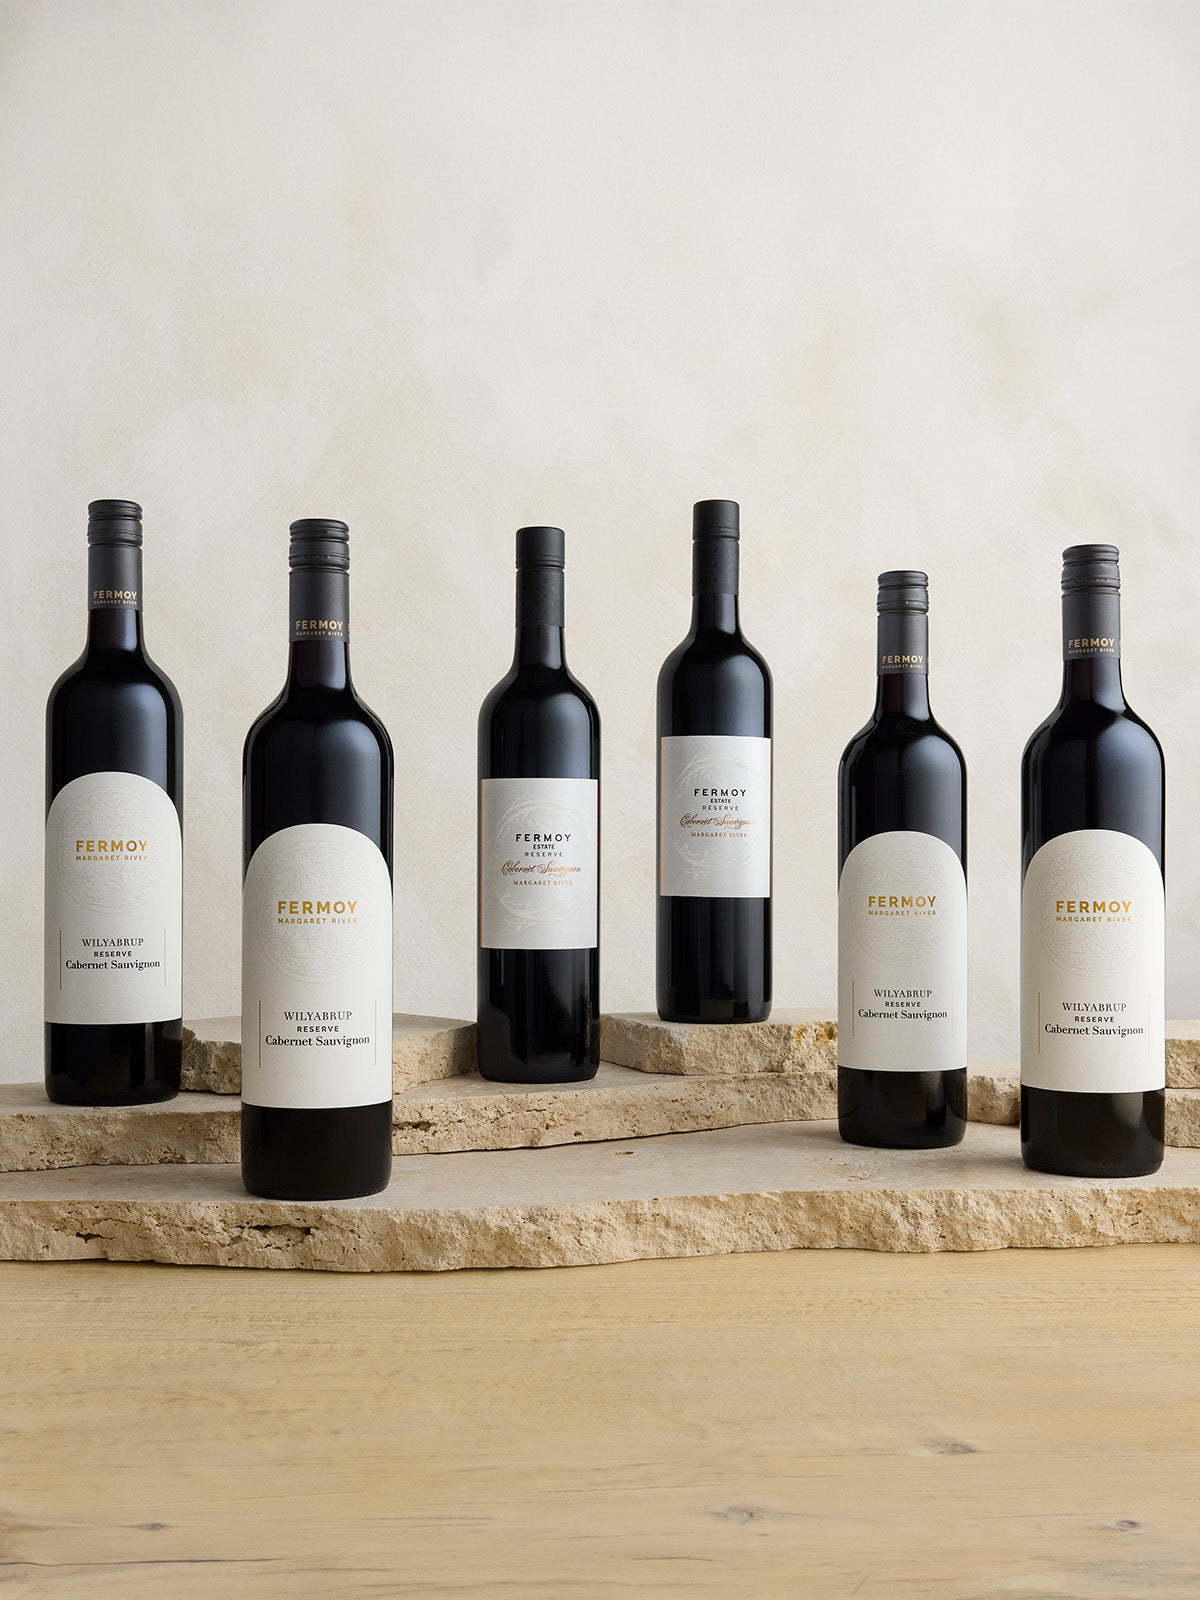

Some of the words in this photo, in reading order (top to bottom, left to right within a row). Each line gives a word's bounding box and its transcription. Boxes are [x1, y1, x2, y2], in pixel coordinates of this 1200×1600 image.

[93, 590, 137, 600] FERMOY
[295, 620, 343, 631] FERMOY
[1068, 638, 1115, 649] FERMOY
[882, 655, 924, 664] FERMOY
[680, 813, 713, 828] Cabernet
[76, 840, 148, 852] FERMOY
[501, 860, 536, 875] Cabernet
[868, 896, 936, 907] FERMOY
[1056, 900, 1132, 913] FERMOY
[278, 901, 357, 914] FERMOY
[82, 938, 144, 946] WILYABRUP
[65, 960, 108, 970] Cabernet
[110, 959, 160, 971] Sauvignon
[874, 989, 932, 998] WILYABRUP
[1062, 1002, 1127, 1012] WILYABRUP
[284, 1011, 352, 1021] WILYABRUP
[858, 1009, 897, 1019] Cabernet
[901, 1010, 947, 1021] Sauvignon
[1045, 1024, 1088, 1035] Cabernet
[1092, 1026, 1143, 1038] Sauvignon
[265, 1035, 312, 1046] Cabernet
[315, 1036, 370, 1048] Sauvignon
